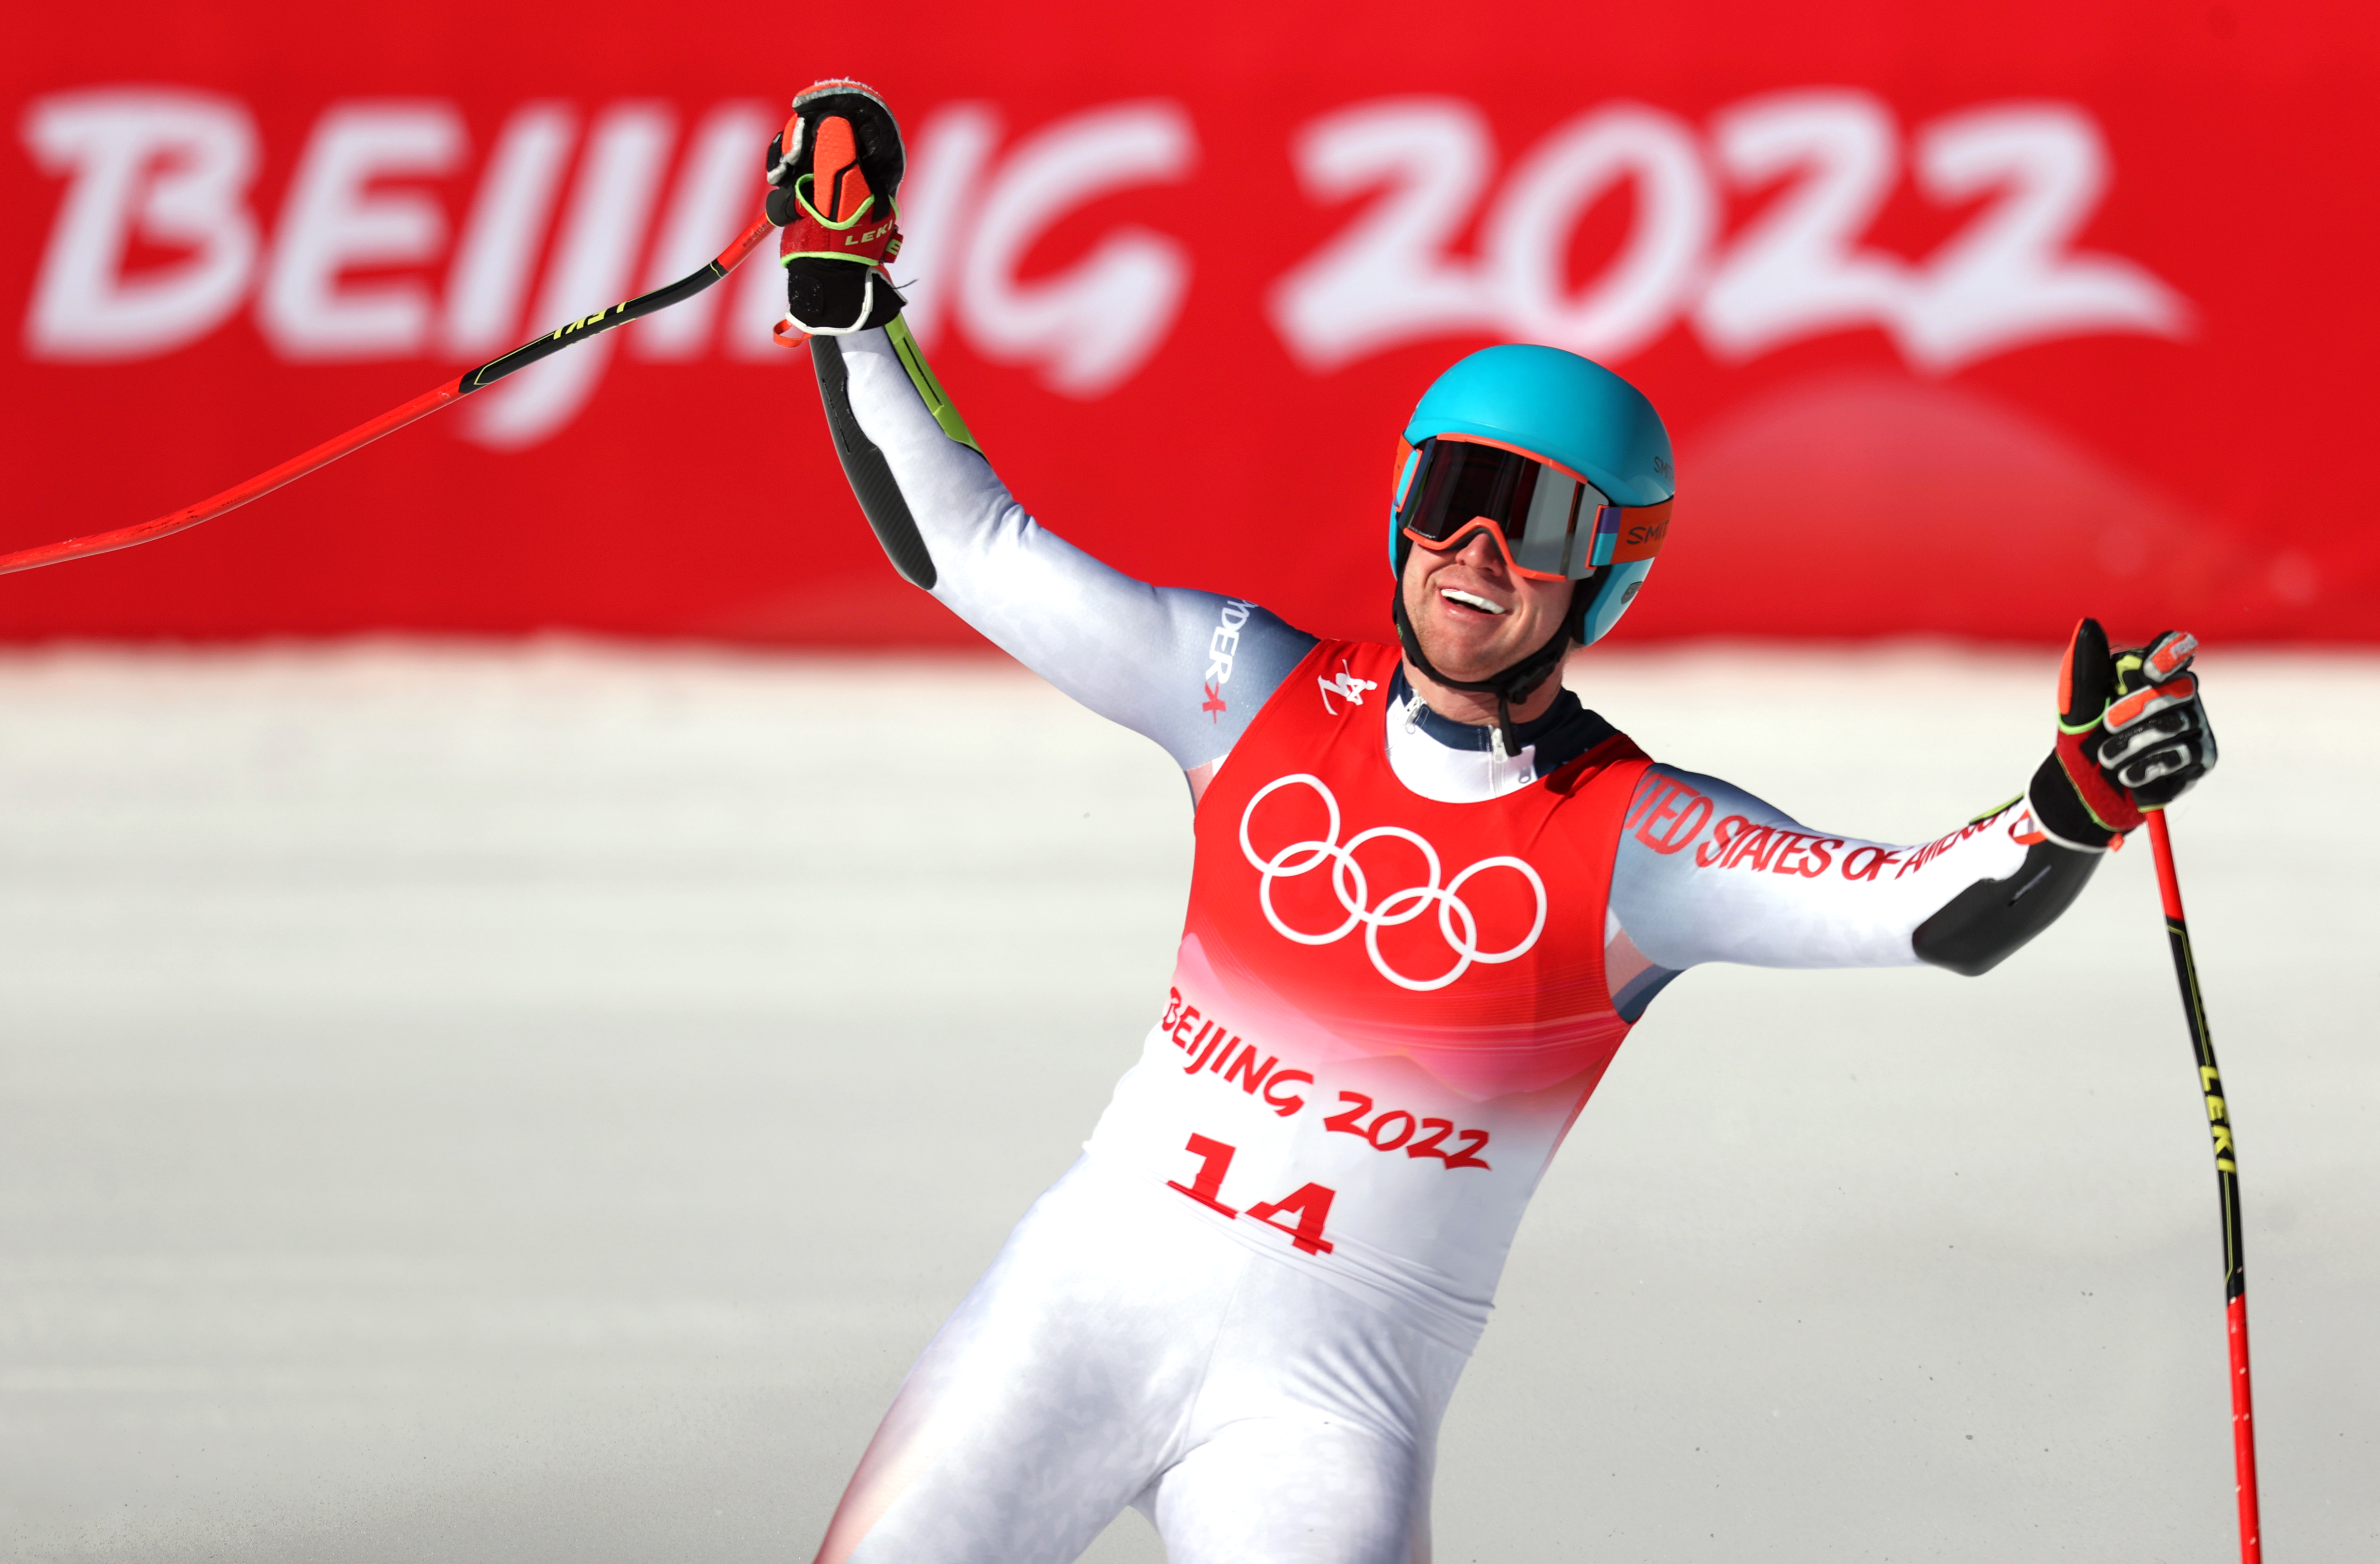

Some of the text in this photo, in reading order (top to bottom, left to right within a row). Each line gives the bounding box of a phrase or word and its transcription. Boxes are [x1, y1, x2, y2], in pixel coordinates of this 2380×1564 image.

[845, 219, 893, 246] LEKI
[1270, 91, 2189, 372] 2022
[1654, 455, 1674, 482] SMIT
[1626, 520, 1669, 545] SMIT
[1205, 599, 1259, 684] YDER
[1695, 814, 1844, 878] STATES
[1841, 846, 1915, 882] OF
[1161, 986, 1493, 1172] BEIJING 2022
[2199, 1064, 2236, 1174] LEKI
[1167, 1132, 1336, 1256] 14
